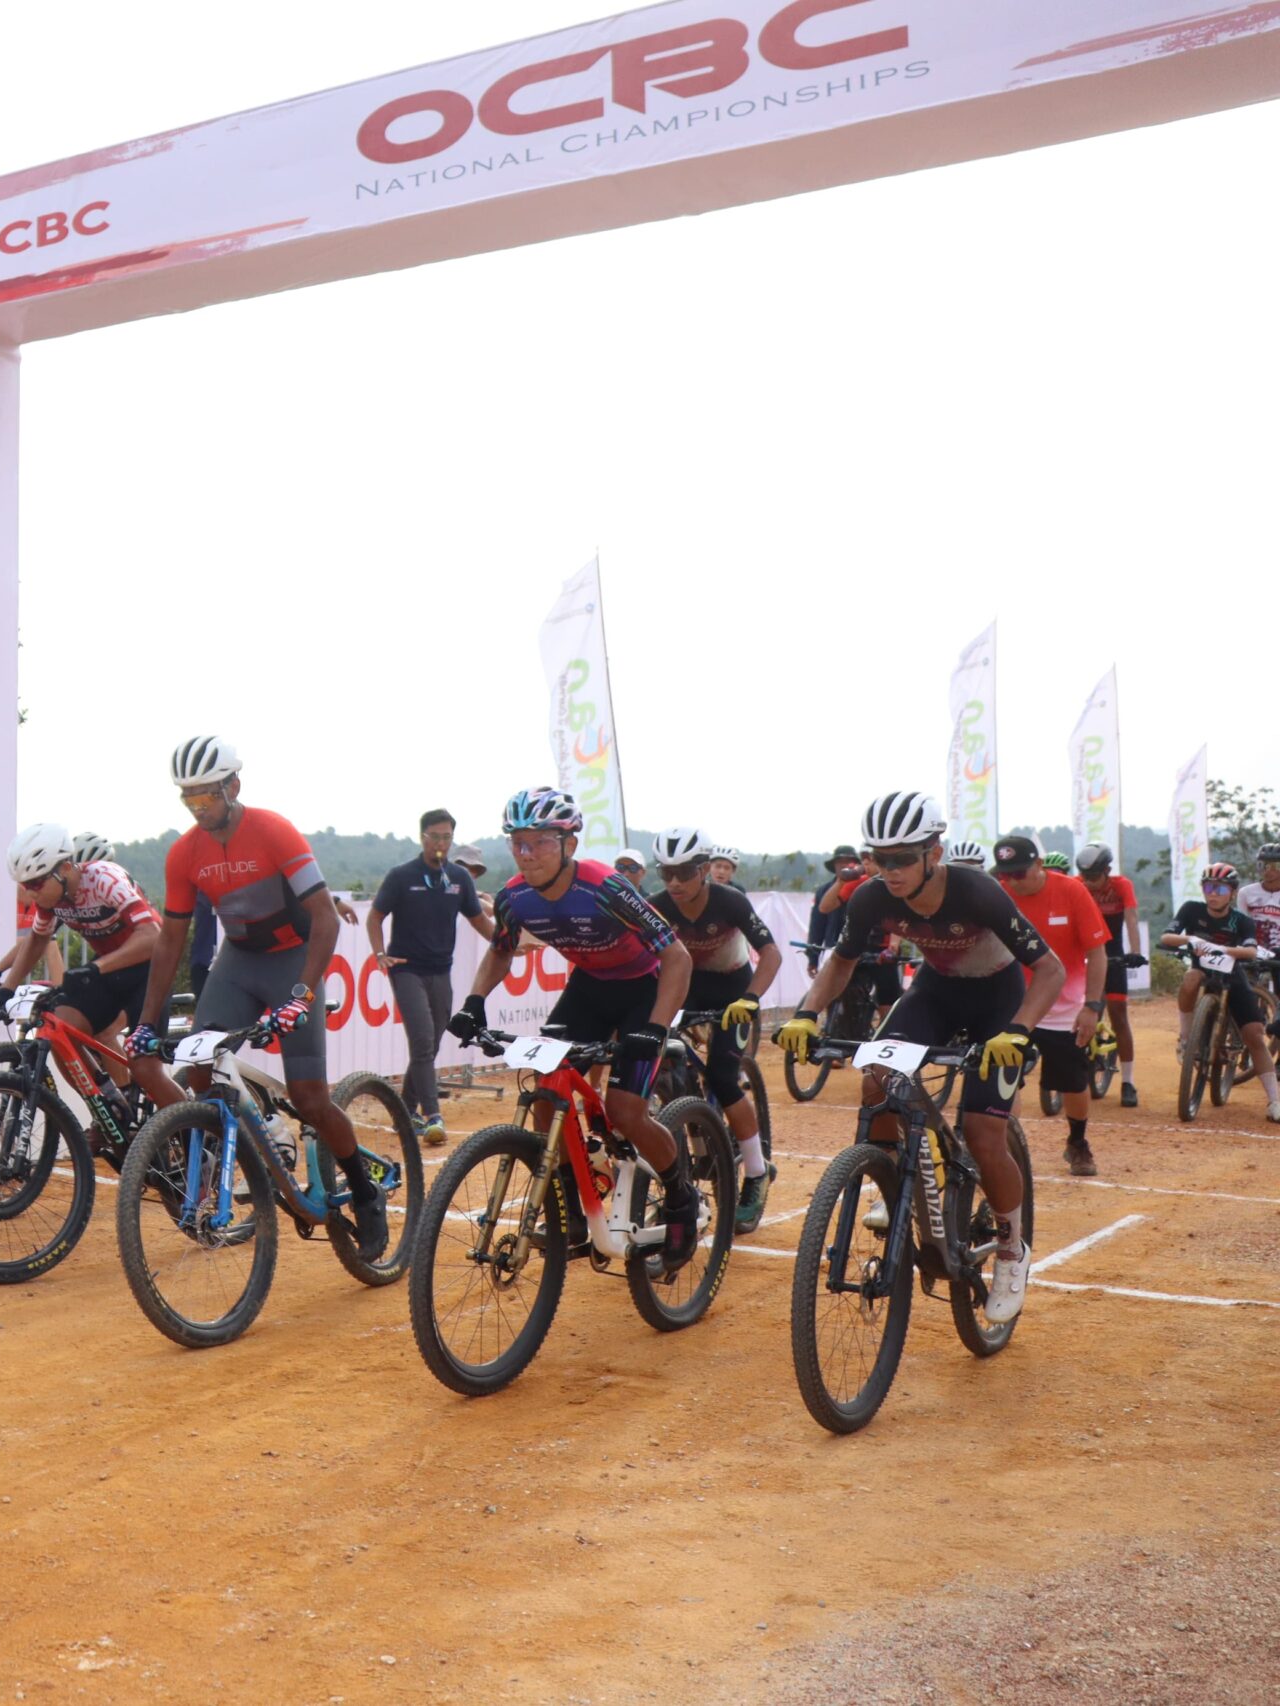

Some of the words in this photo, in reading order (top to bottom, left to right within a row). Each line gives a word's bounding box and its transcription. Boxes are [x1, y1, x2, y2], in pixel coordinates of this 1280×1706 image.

[356, 0, 908, 164] OCBC
[354, 148, 544, 200] NATIONAL
[560, 59, 932, 153] CHAMPIONSHIPS
[617, 890, 645, 913] ALPEN
[642, 911, 666, 932] BLICK
[323, 953, 404, 1032] OC
[499, 1006, 549, 1025] NATIONAL
[189, 1037, 204, 1057] 2
[523, 1044, 542, 1061] 4
[878, 1045, 897, 1059] 5
[71, 1060, 124, 1144] POLYGON
[552, 1178, 567, 1233] MAXXIS
[919, 1135, 946, 1239] PECIALIZED
